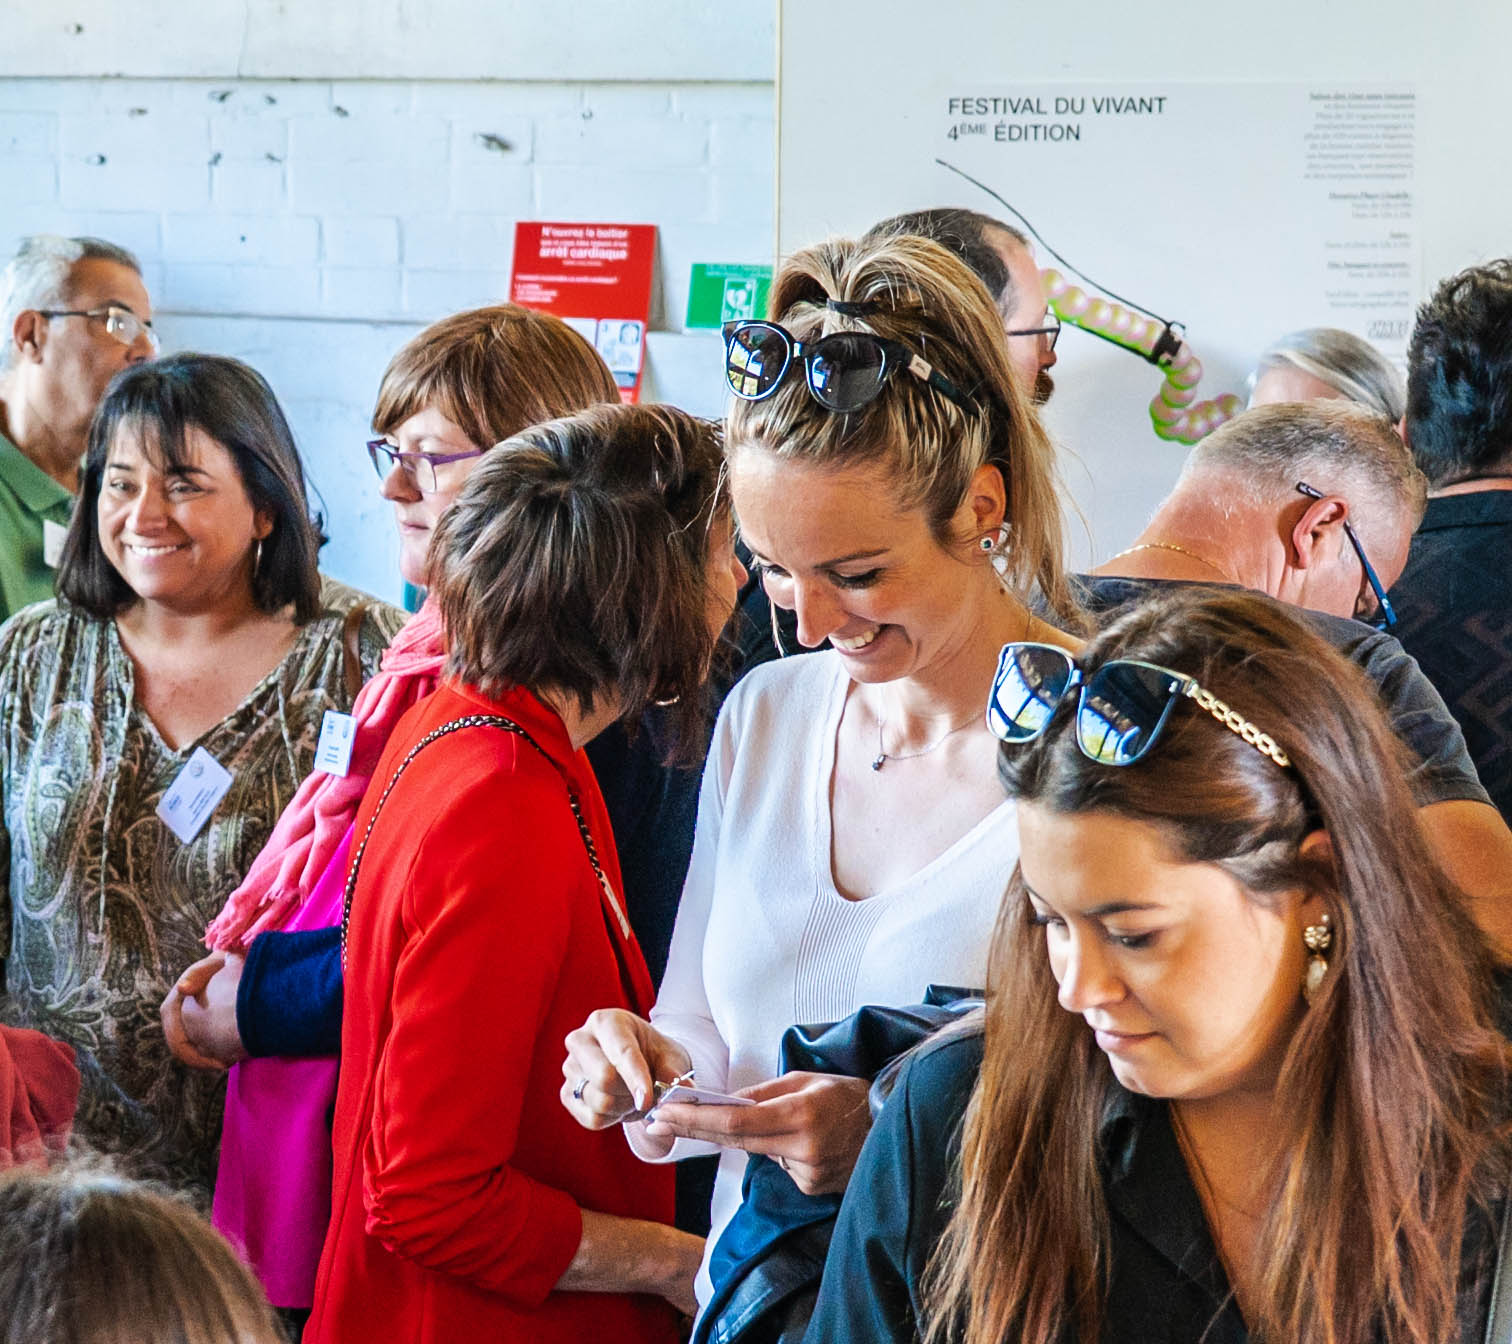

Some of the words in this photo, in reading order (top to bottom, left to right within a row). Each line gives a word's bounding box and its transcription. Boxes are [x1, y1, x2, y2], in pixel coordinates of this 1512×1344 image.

[948, 97, 1047, 115] FESTIVAL
[1054, 97, 1085, 115] DU
[1092, 96, 1167, 114] VIVANT
[994, 120, 1080, 142] ÉDITION
